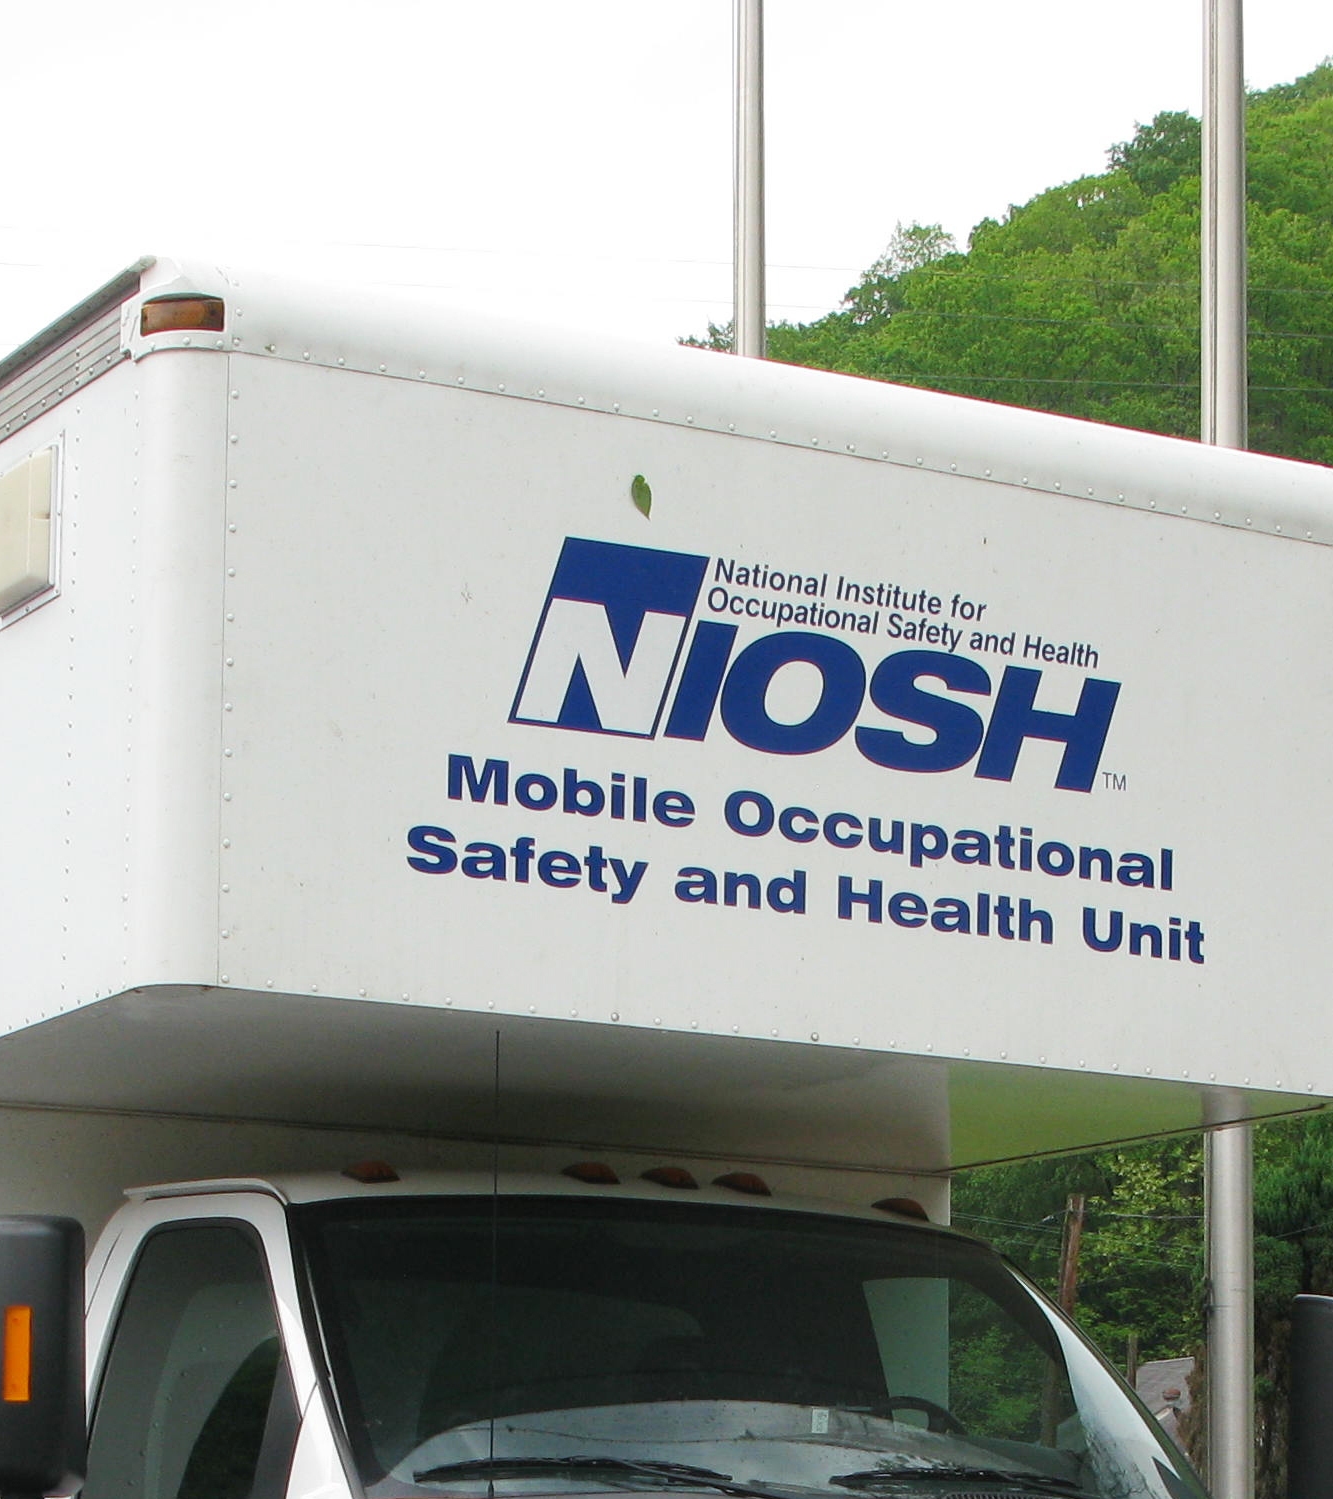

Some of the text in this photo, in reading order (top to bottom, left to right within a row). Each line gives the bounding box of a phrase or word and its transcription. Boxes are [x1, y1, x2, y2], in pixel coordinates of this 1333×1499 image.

[707, 586, 1100, 669] Occupational Safety and Health
[713, 557, 988, 622] National Institute for
[509, 596, 1127, 793] NIOSH TM
[447, 753, 1174, 891] Mobile Occupational
[406, 825, 1205, 965] Safety and Health Unit
